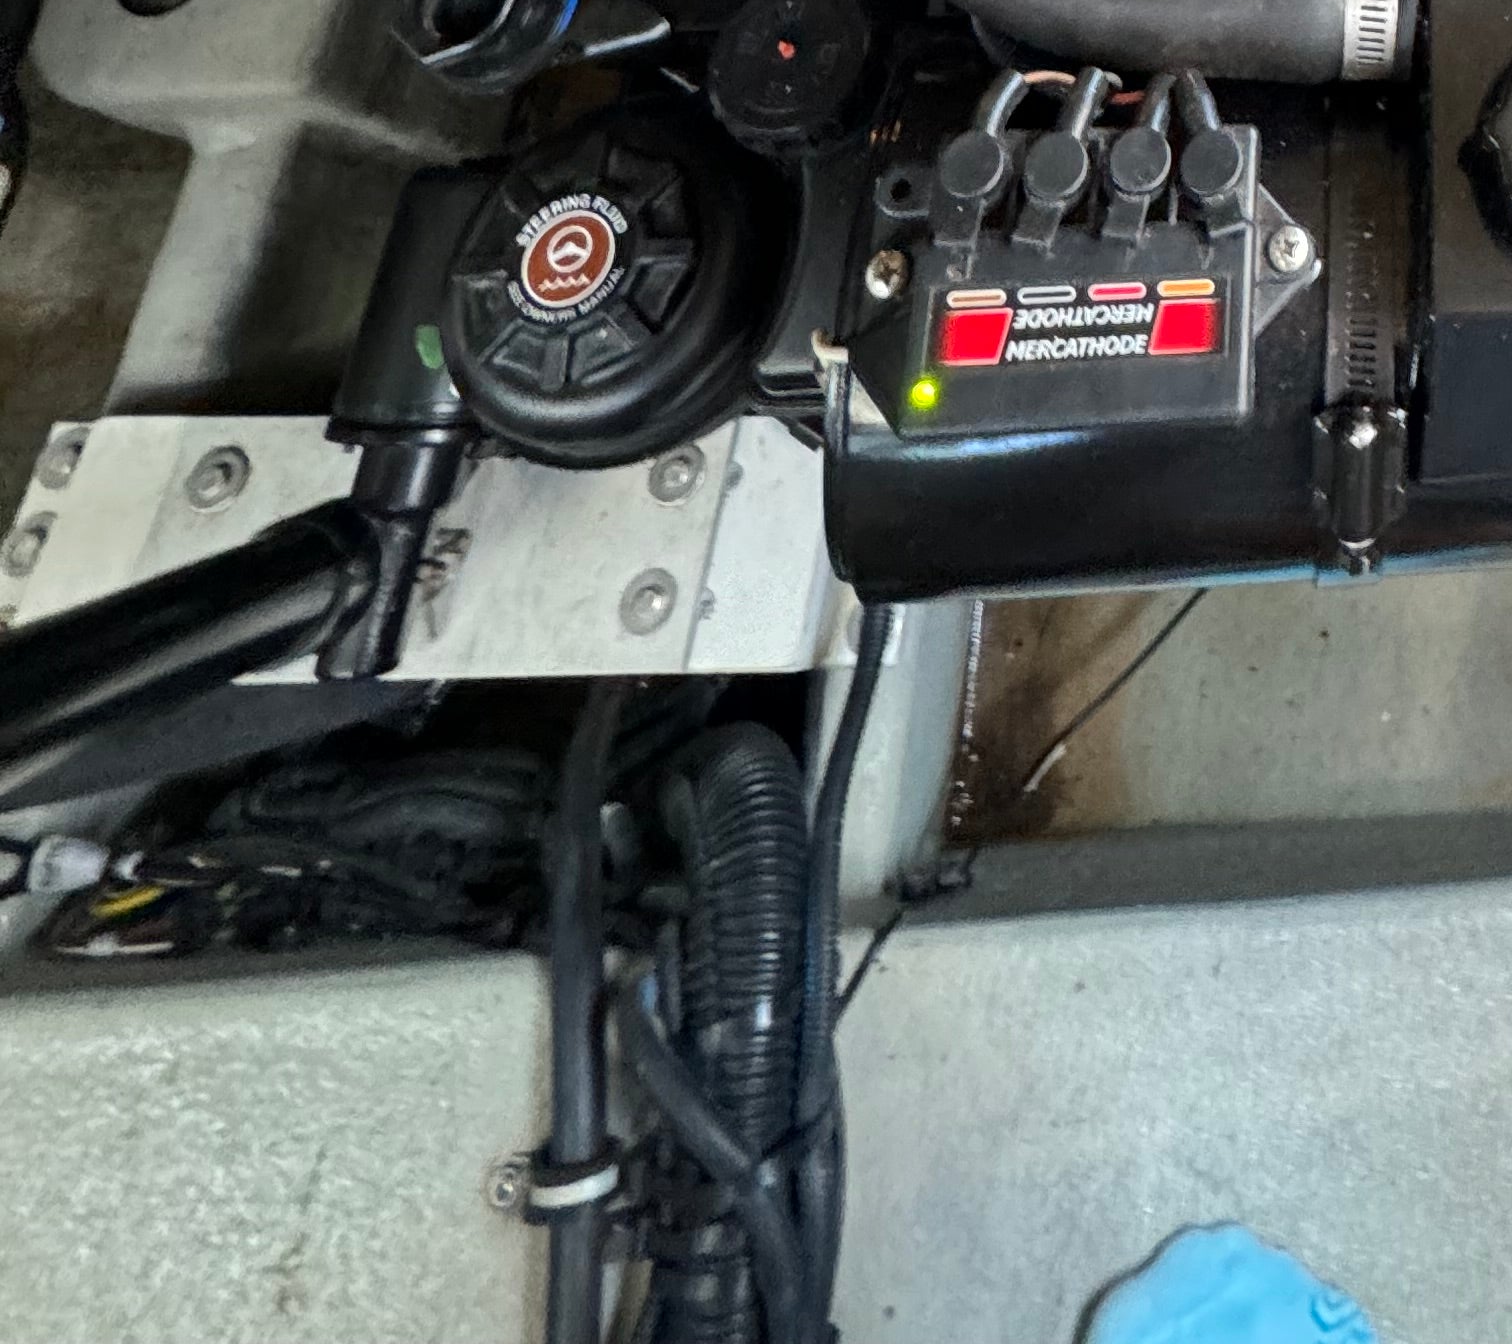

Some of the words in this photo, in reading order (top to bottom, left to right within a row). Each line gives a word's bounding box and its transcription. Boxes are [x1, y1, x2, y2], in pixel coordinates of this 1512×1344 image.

[515, 193, 591, 247] STEERING
[591, 195, 628, 234] FLUID
[1012, 302, 1155, 330] MERCATHODE
[1005, 333, 1149, 362] MERCATHODE
